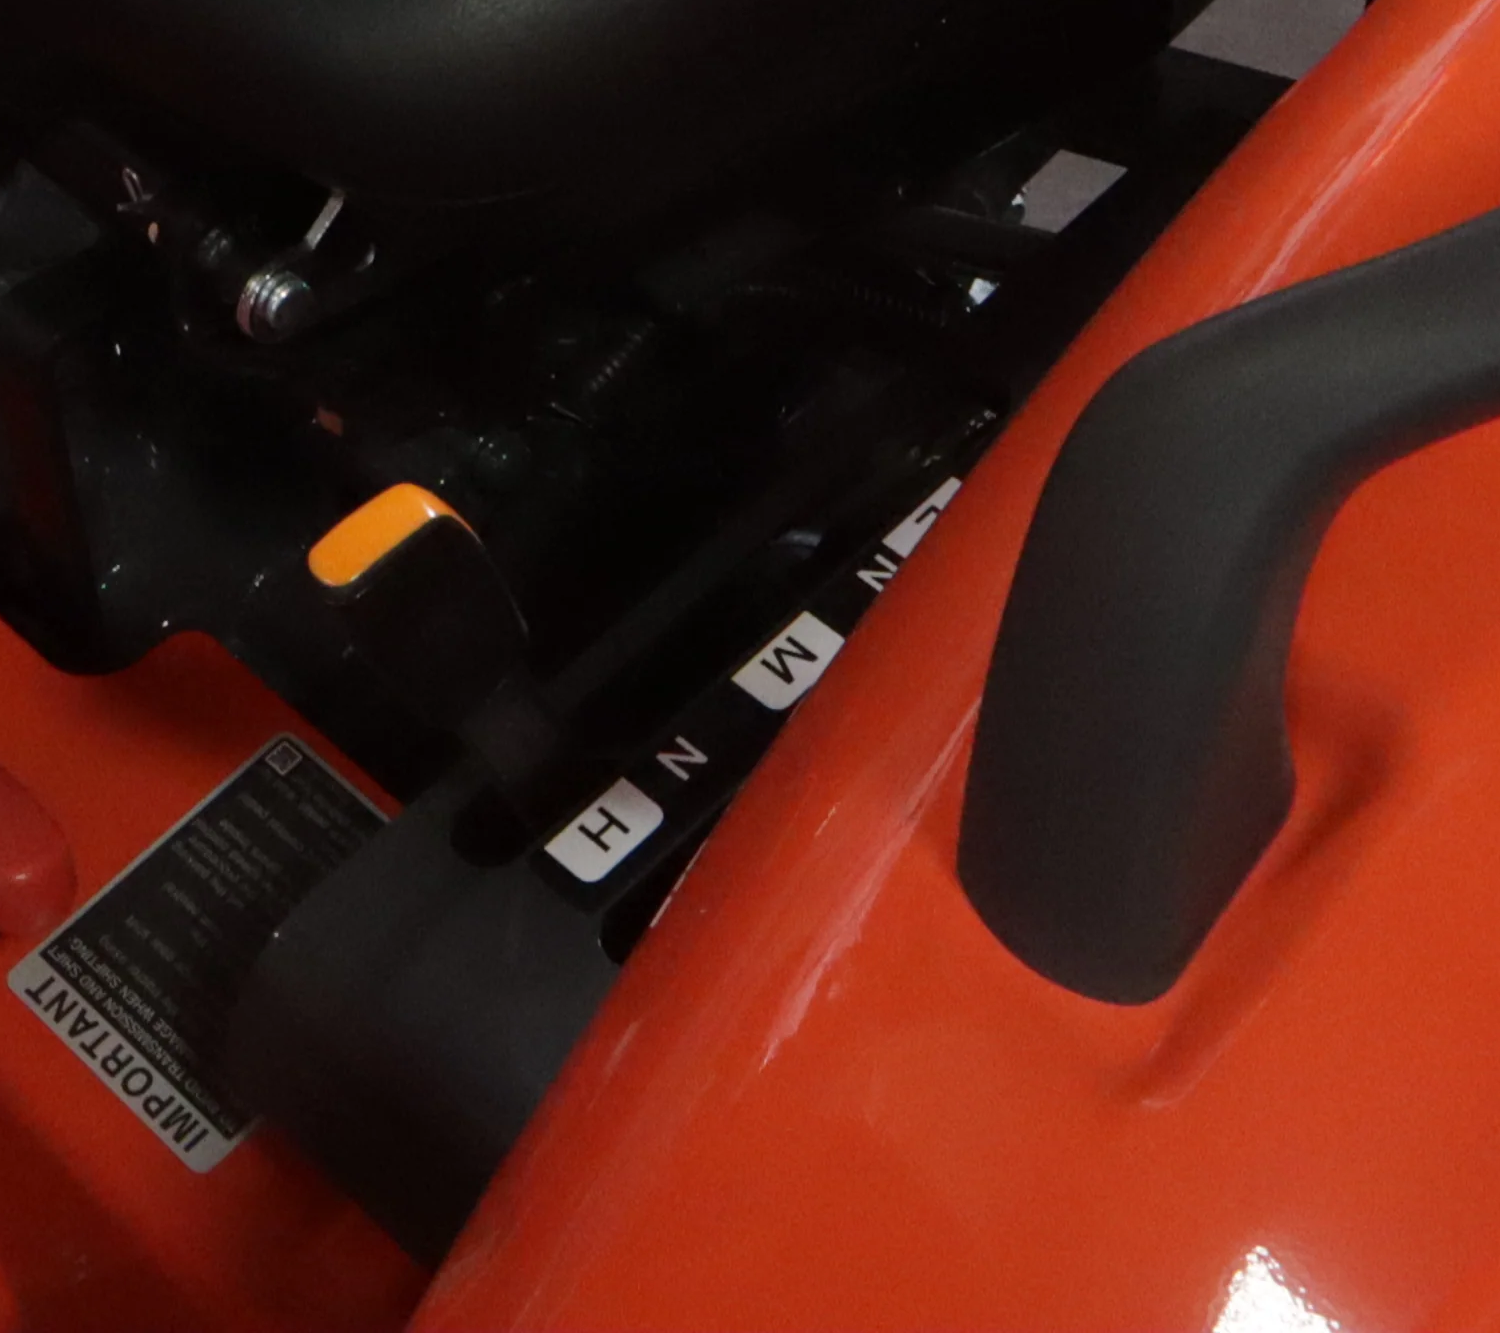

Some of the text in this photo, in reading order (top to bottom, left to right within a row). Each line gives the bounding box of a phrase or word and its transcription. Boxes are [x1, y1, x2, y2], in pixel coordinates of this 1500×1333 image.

[856, 553, 899, 593] N
[759, 635, 820, 686] M
[656, 735, 709, 782] N
[577, 807, 631, 853] H
[47, 945, 82, 977] SHIFT
[77, 973, 107, 1001] AND
[118, 985, 155, 1020] WHEN
[104, 999, 185, 1077] TRANSMISSION
[27, 979, 209, 1153] IMPORTANT
